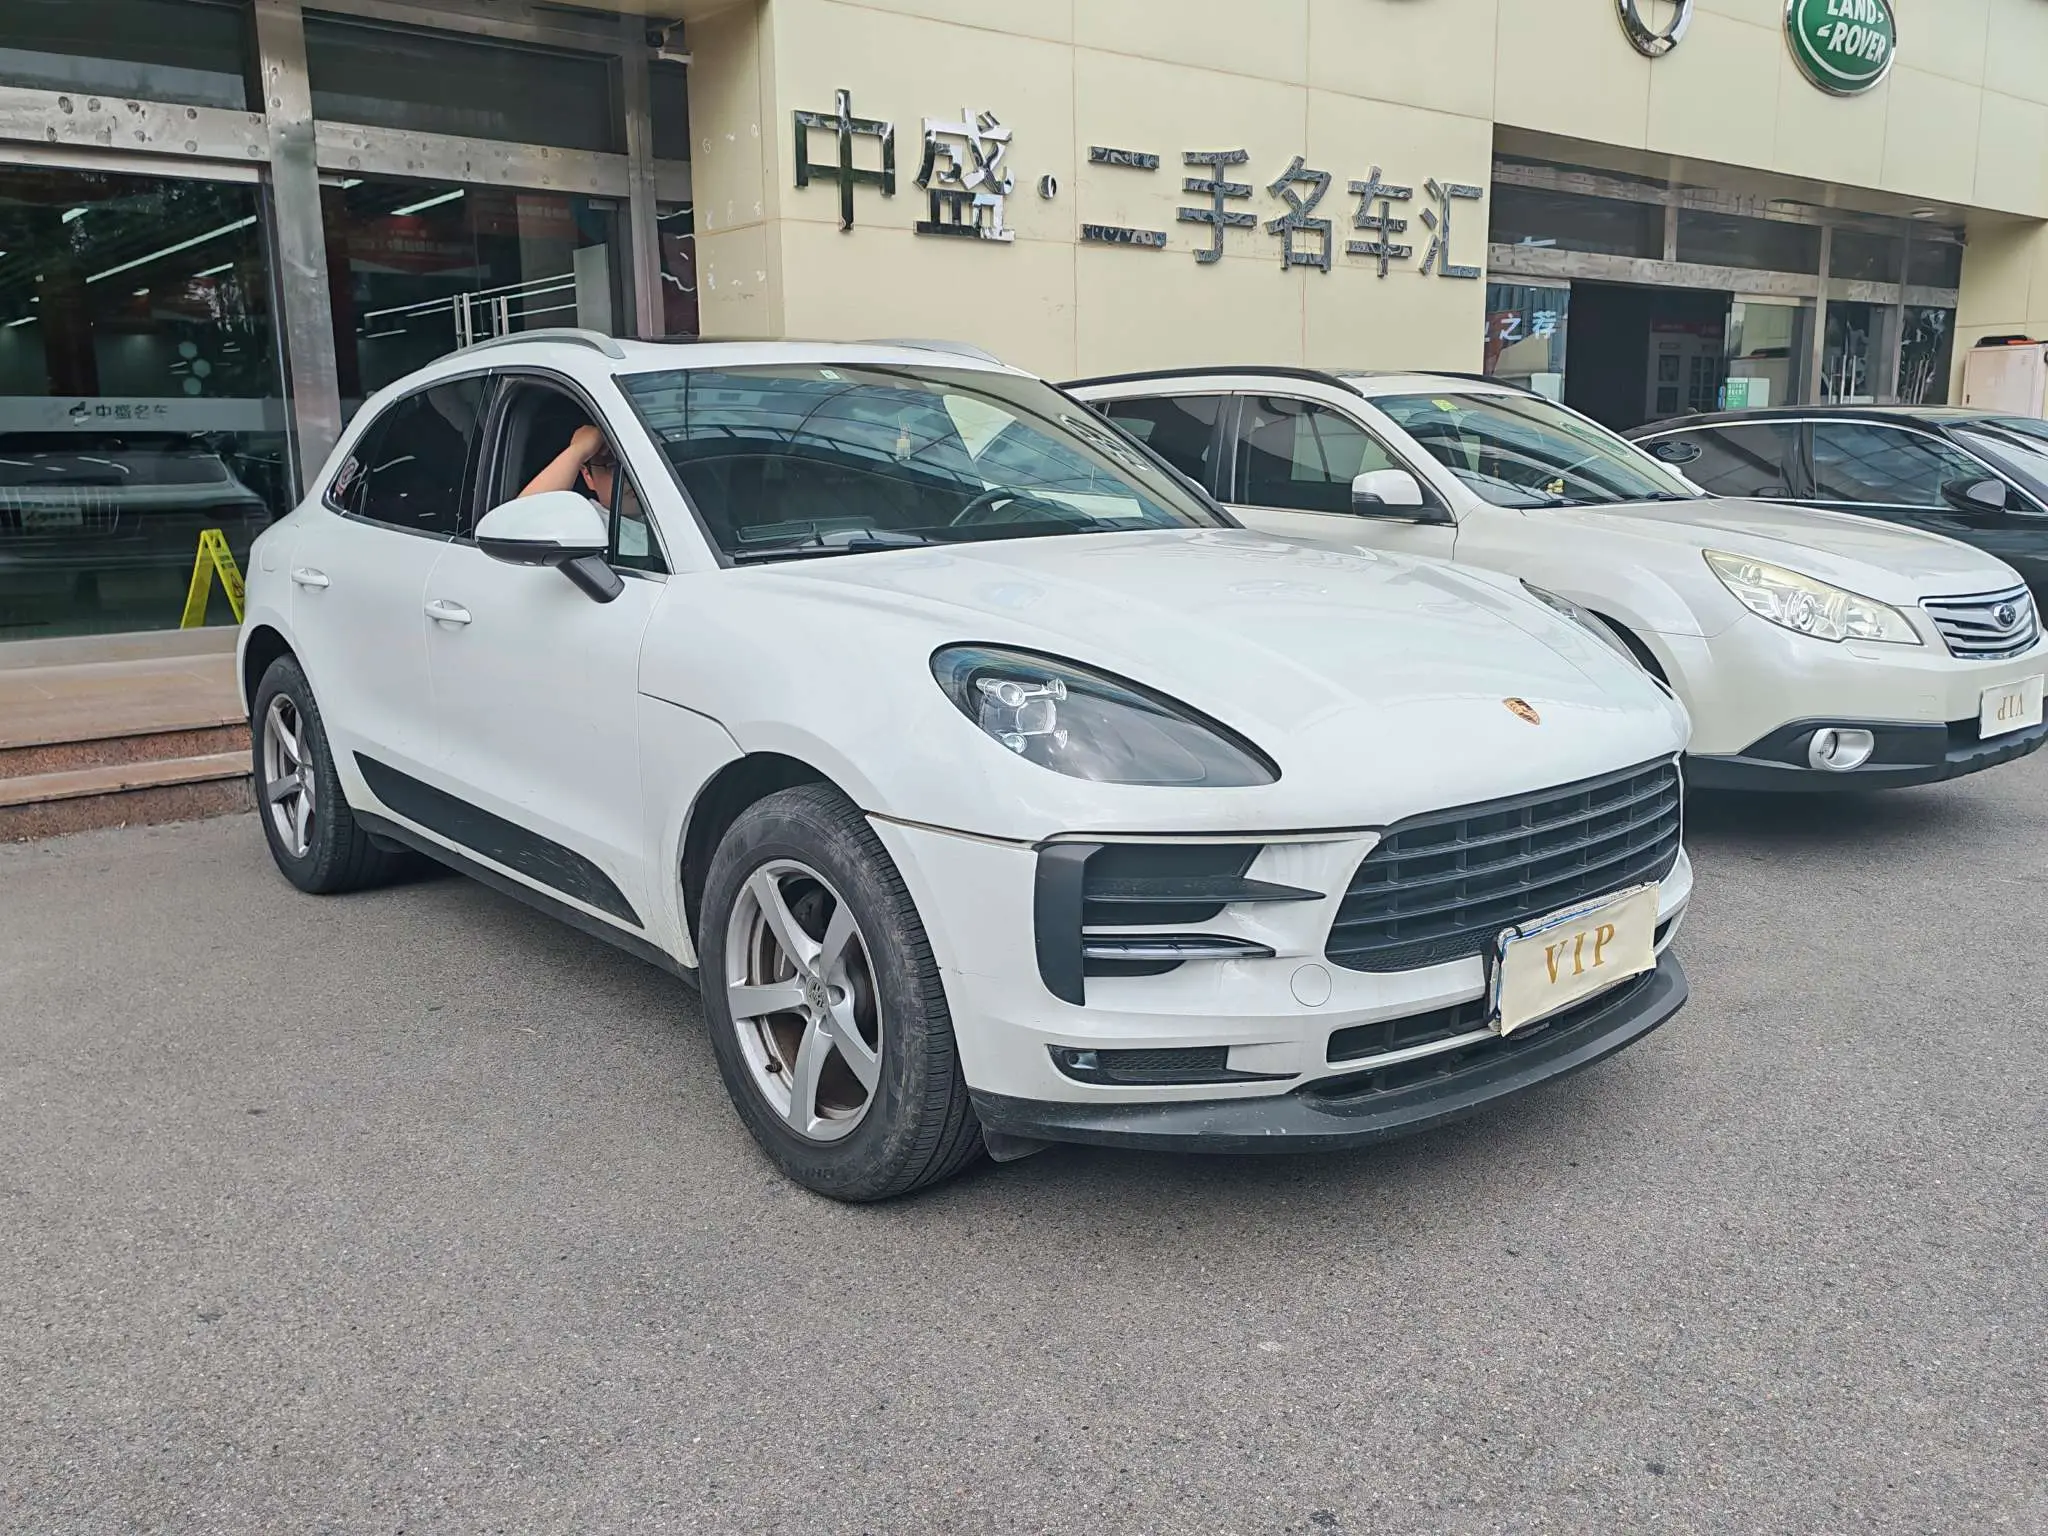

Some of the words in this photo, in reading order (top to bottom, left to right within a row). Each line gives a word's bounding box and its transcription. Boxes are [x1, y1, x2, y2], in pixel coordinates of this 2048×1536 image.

[1826, 0, 1877, 24] LAND
[1827, 21, 1887, 64] ROVER
[1996, 692, 2024, 721] VIP
[1545, 923, 1615, 984] VIP
